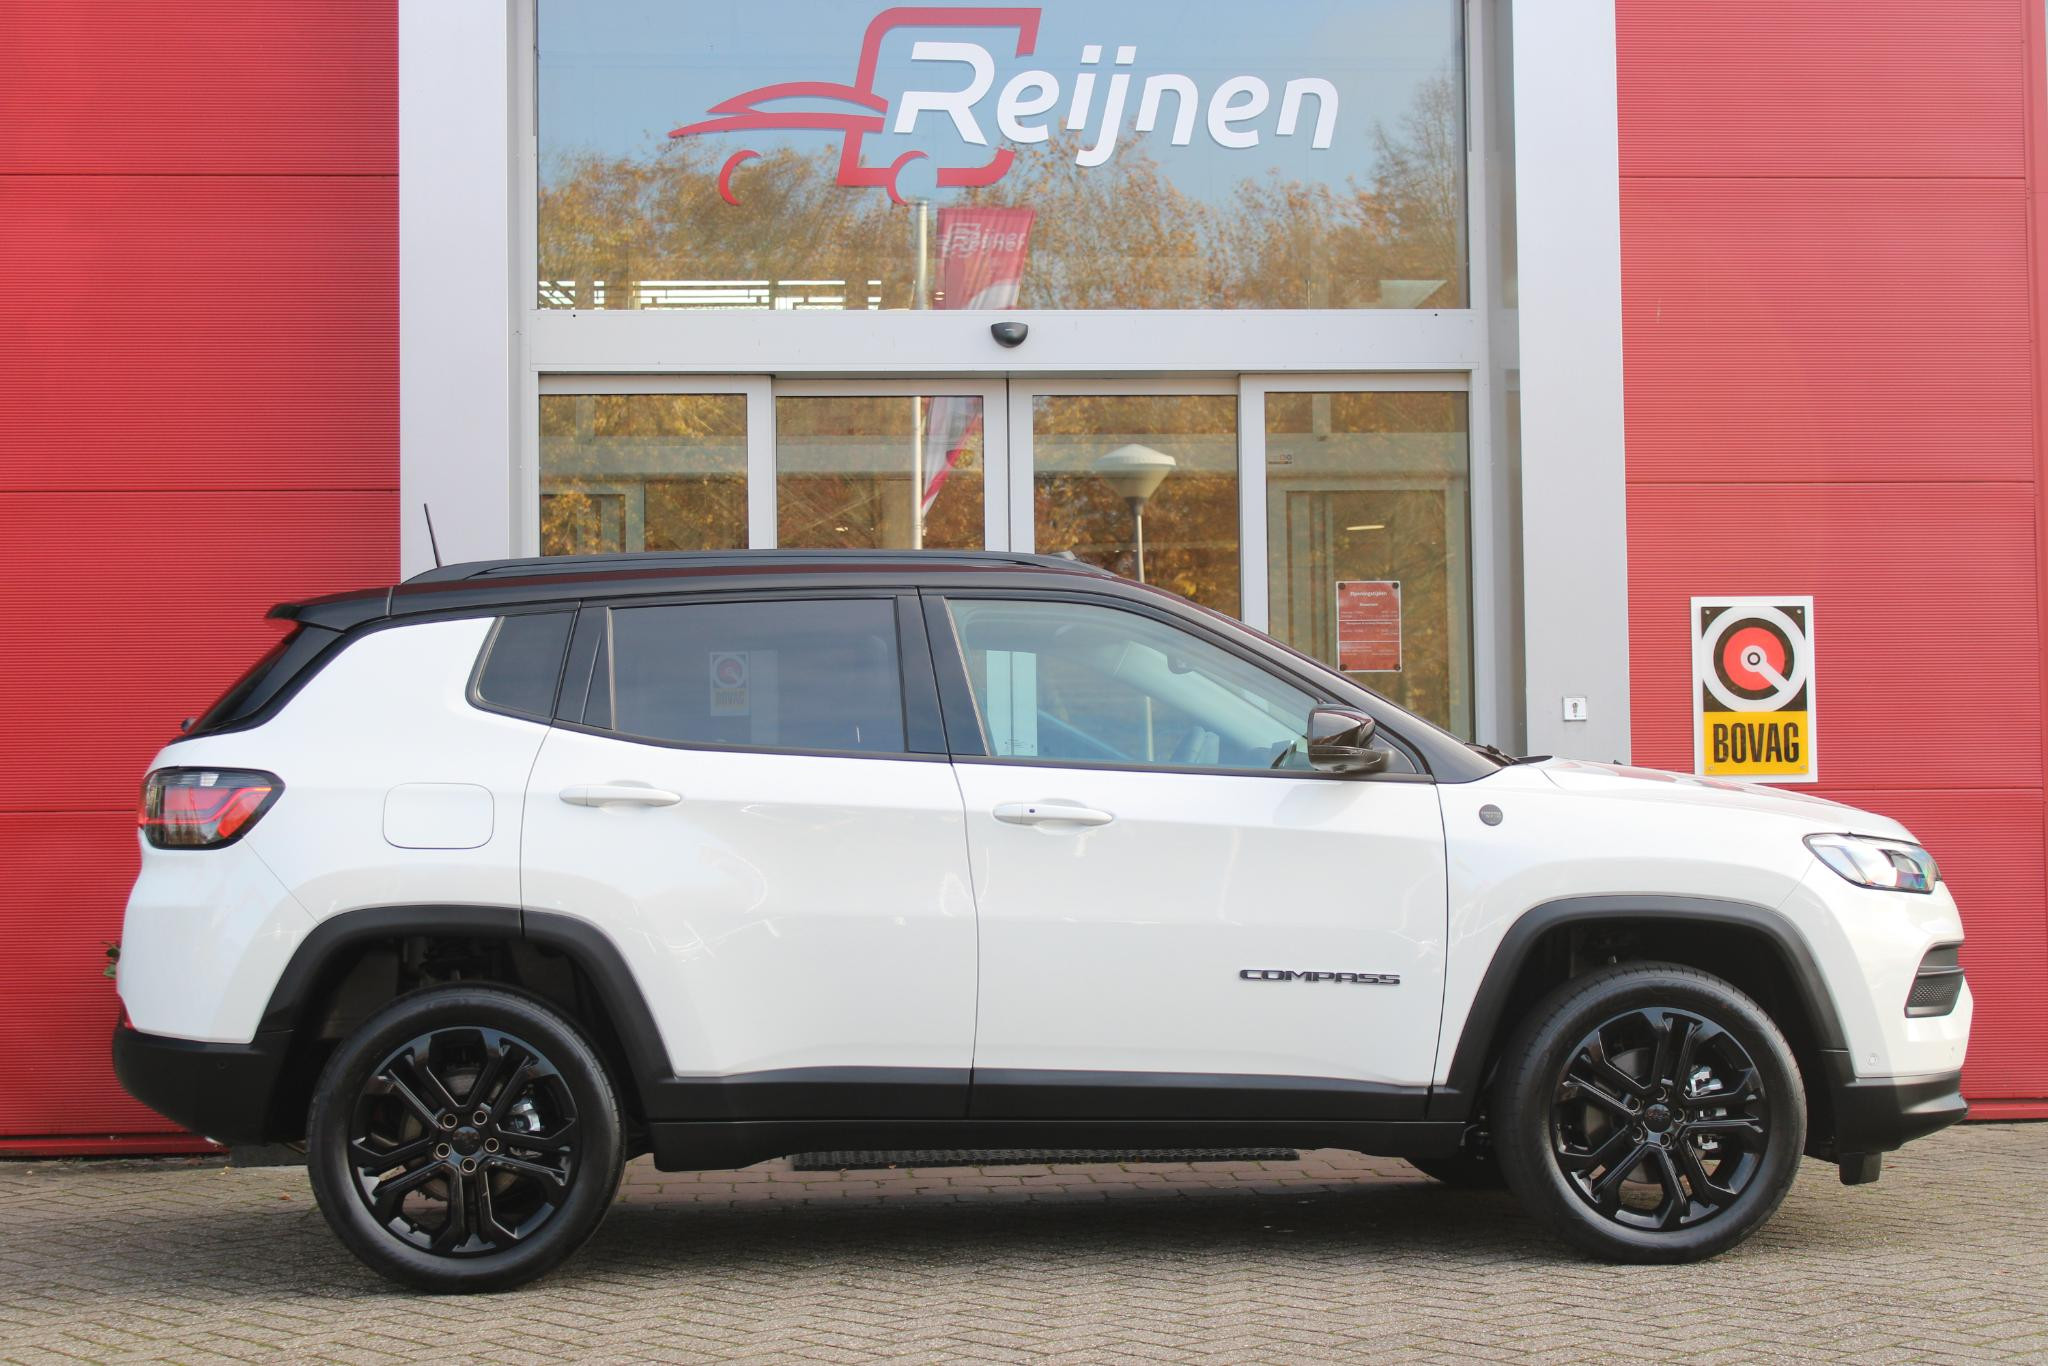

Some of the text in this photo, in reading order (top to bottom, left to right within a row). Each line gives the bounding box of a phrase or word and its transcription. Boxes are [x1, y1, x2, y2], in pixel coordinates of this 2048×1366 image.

[894, 42, 1339, 166] Reijnen
[1713, 722, 1799, 764] BOVAG
[1239, 969, 1401, 985] COMPASS
